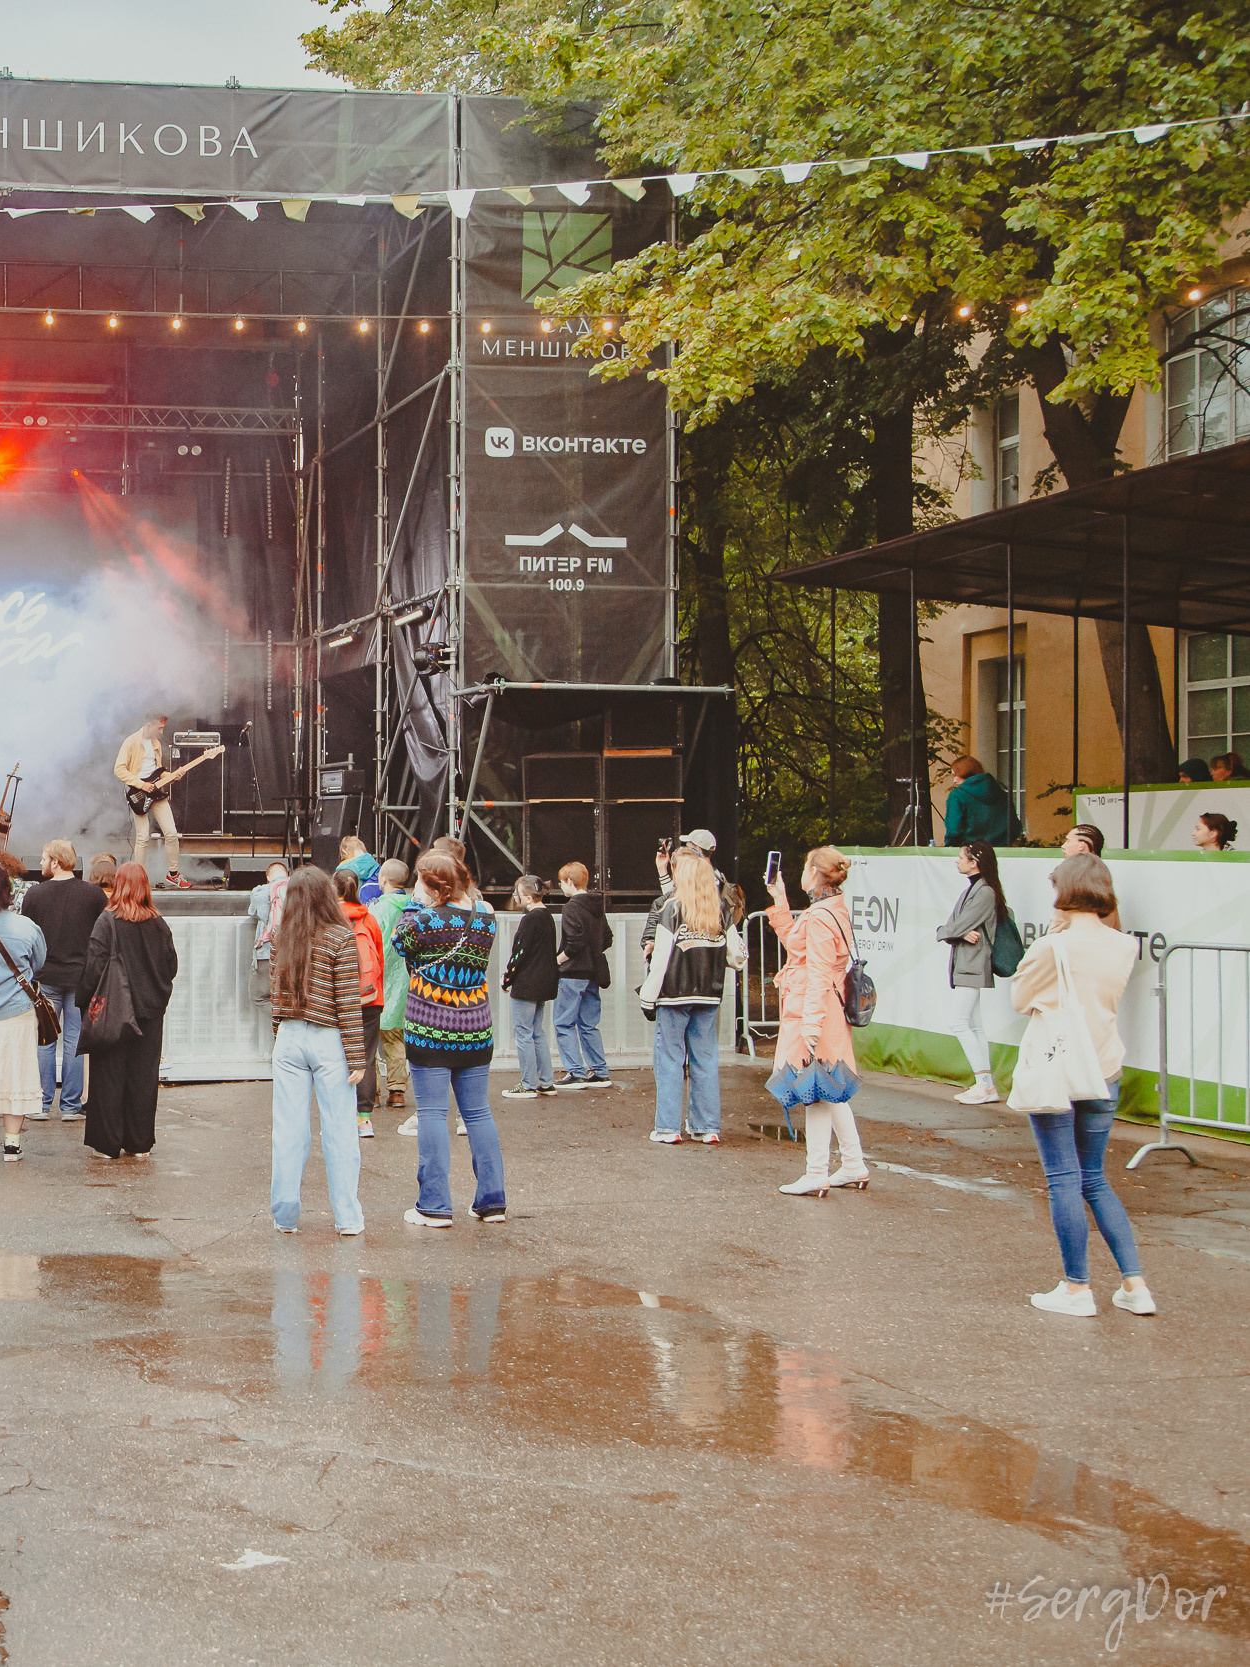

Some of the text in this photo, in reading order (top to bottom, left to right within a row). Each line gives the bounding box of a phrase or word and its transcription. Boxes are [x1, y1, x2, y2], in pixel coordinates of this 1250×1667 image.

[519, 556, 613, 573] ПИТЕР FM
[547, 578, 586, 592] 100.9
